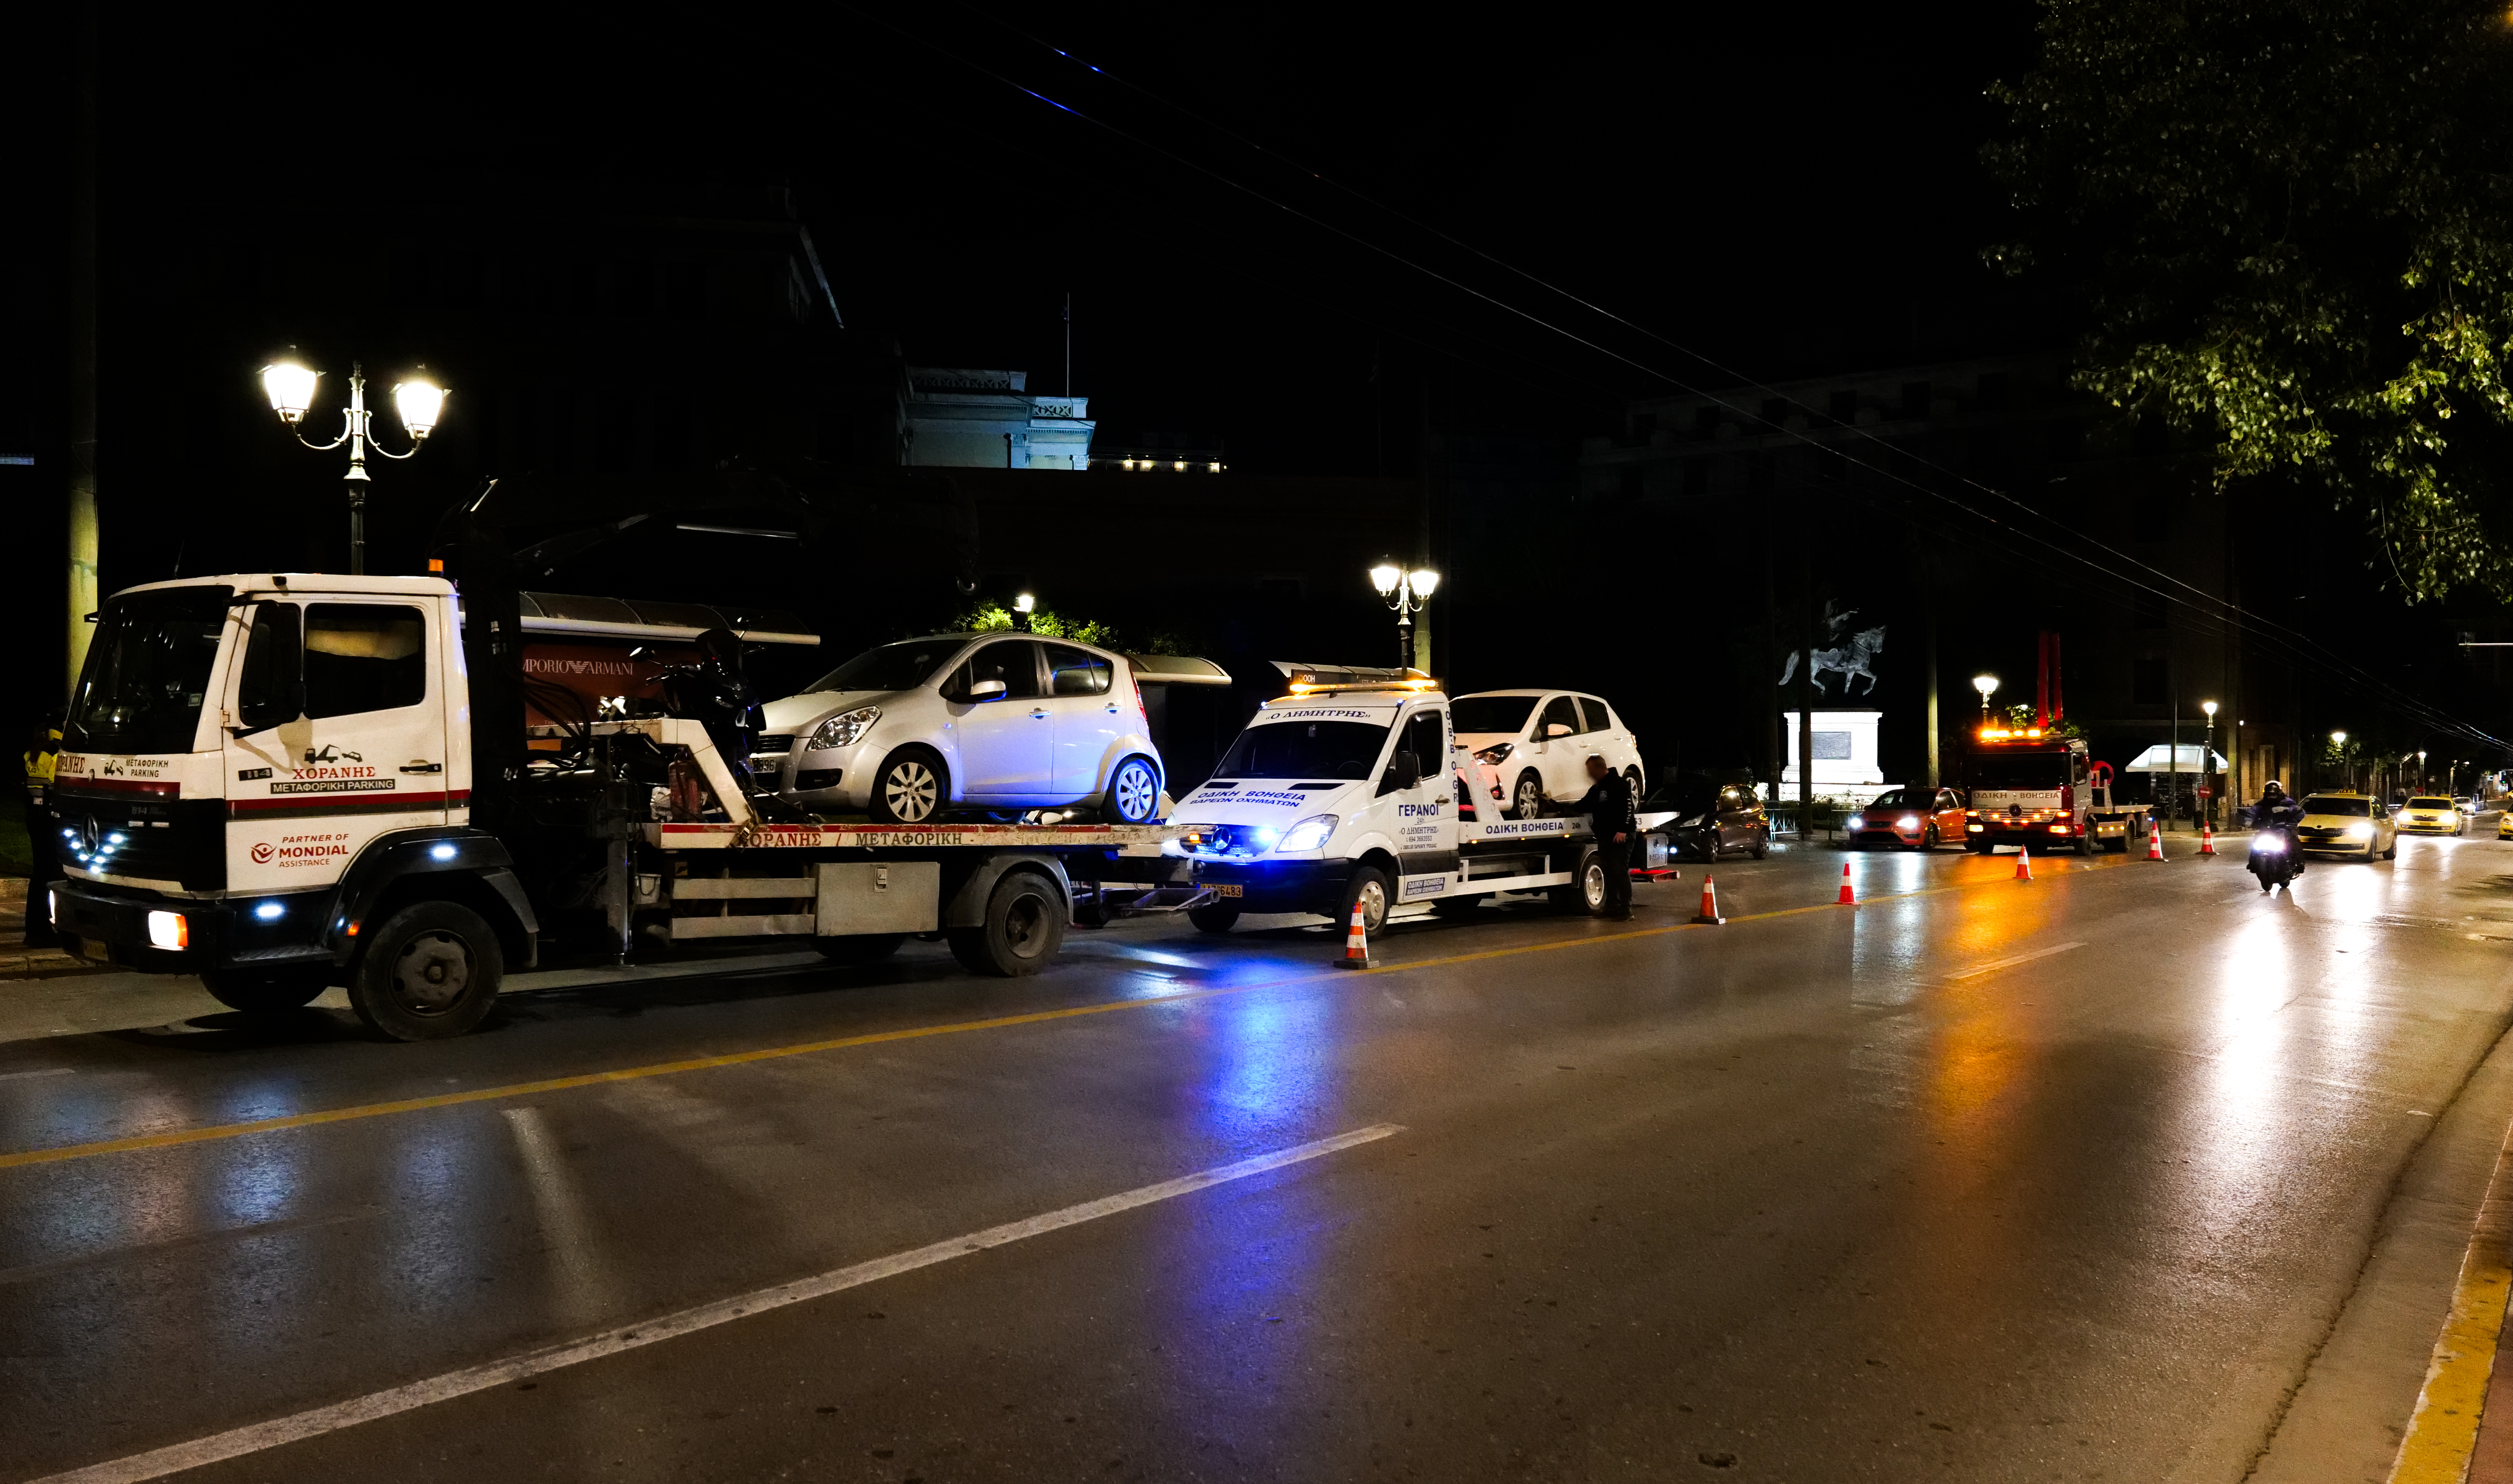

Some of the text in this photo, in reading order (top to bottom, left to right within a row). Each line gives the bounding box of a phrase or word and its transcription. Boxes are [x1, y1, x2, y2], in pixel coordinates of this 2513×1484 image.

[586, 662, 633, 675] ARMANI
[126, 758, 168, 768] ΜΕΤΑΦΟΡΙΚΗ
[131, 769, 159, 778] PARKING
[292, 766, 376, 780] ΧΟΡΑΝΗΣ
[273, 780, 393, 793] ΜΕΤΑΦΟΡΙΚΗ PARKING
[1236, 798, 1300, 807] ΟΧΗΜΑΤΩΝ
[1245, 791, 1306, 801] ΒΟΗΘΕΙΑ
[1398, 804, 1439, 817] ΓΕΡΑΝΟΙ
[1486, 824, 1518, 835] ΟΔΙΚΗ
[1521, 822, 1564, 832] ΒΟΗΘΕΙΑ
[282, 835, 332, 843] PARTNER
[855, 832, 962, 846] ΜΕΤΑΦΟΡΙΚΗ
[279, 845, 349, 858] MONDIAL
[279, 858, 330, 868] ASSISTANCE
